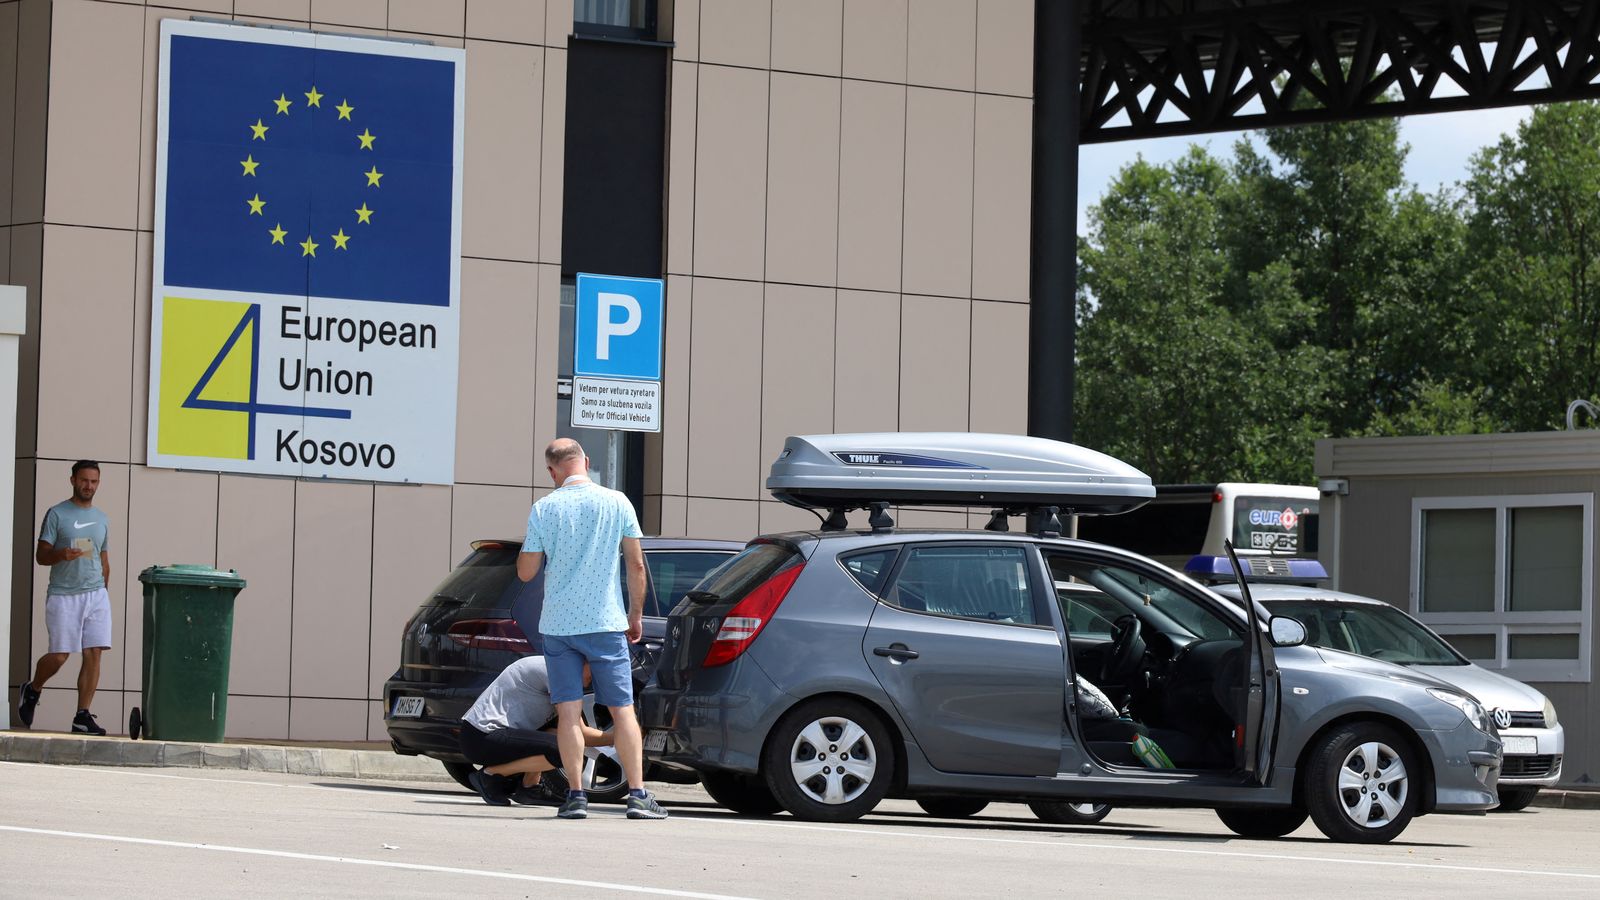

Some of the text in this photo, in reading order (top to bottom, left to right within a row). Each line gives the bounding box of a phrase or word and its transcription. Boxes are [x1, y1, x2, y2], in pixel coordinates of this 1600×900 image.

[280, 305, 437, 352] European
[596, 292, 642, 360] P
[278, 357, 374, 396] Union
[579, 383, 655, 398] Vetem per vetura zyretare
[581, 396, 652, 410] Samo za sluzbena vozila
[581, 409, 595, 420] Only
[606, 411, 628, 421] Official
[629, 413, 651, 422] Vehicle
[276, 429, 396, 469] Kosovo
[849, 454, 880, 463] THULE
